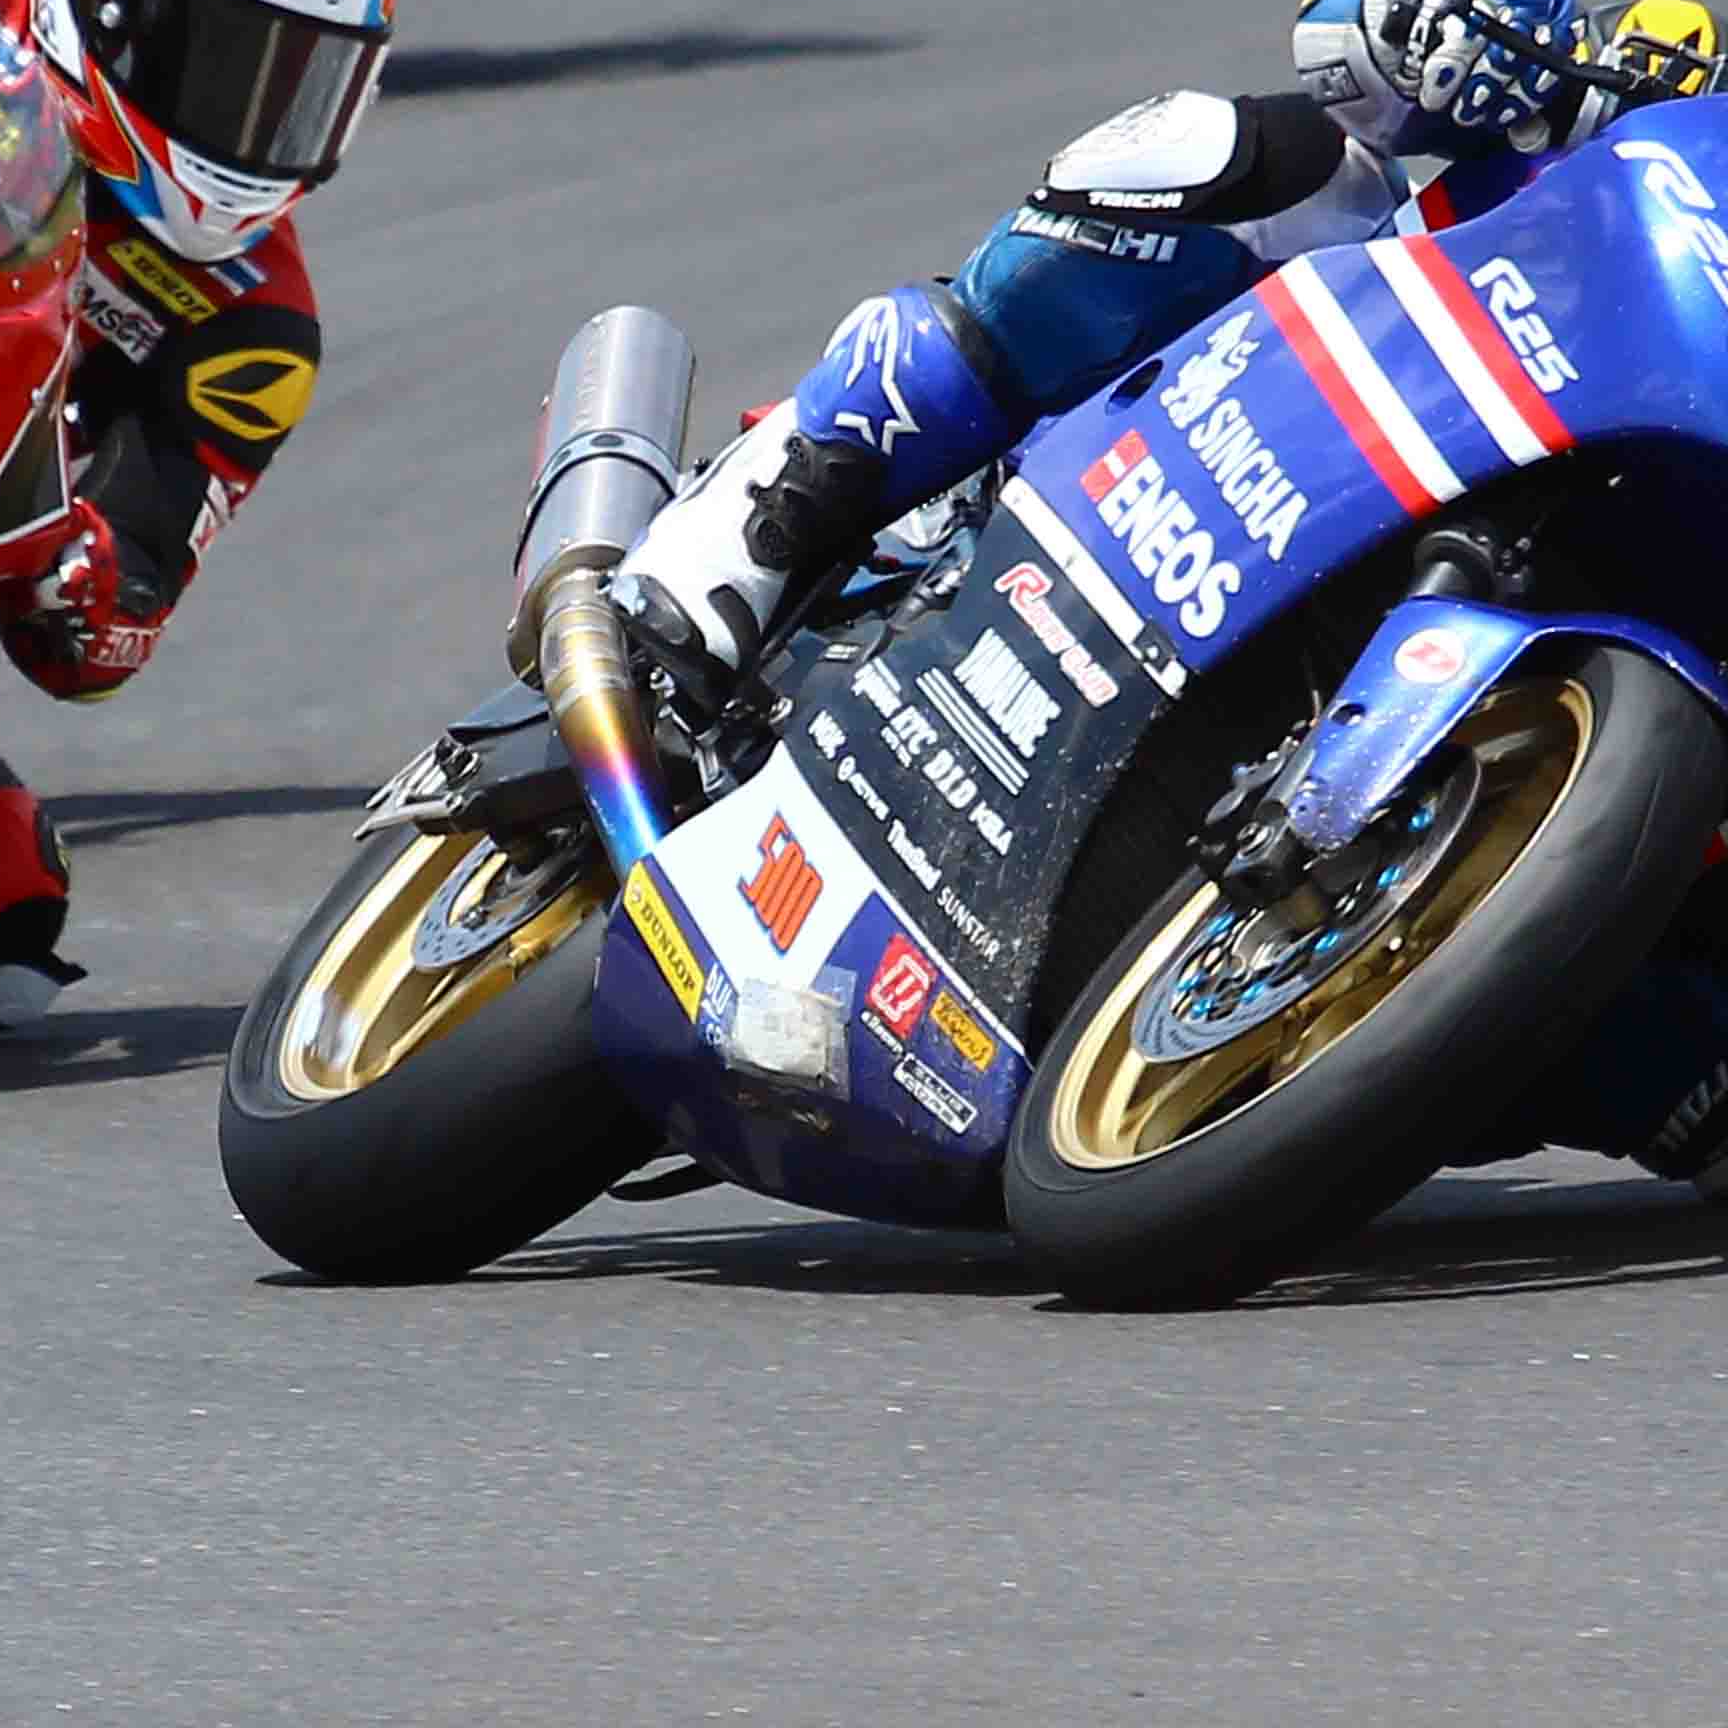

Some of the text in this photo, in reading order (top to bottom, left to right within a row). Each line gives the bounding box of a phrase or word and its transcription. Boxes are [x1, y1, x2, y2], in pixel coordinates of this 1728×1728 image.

[1469, 256, 1581, 393] R25
[1095, 455, 1242, 638] ENEOS
[638, 903, 697, 993] DUNLOP
[937, 885, 1001, 961] SUNSTAR
